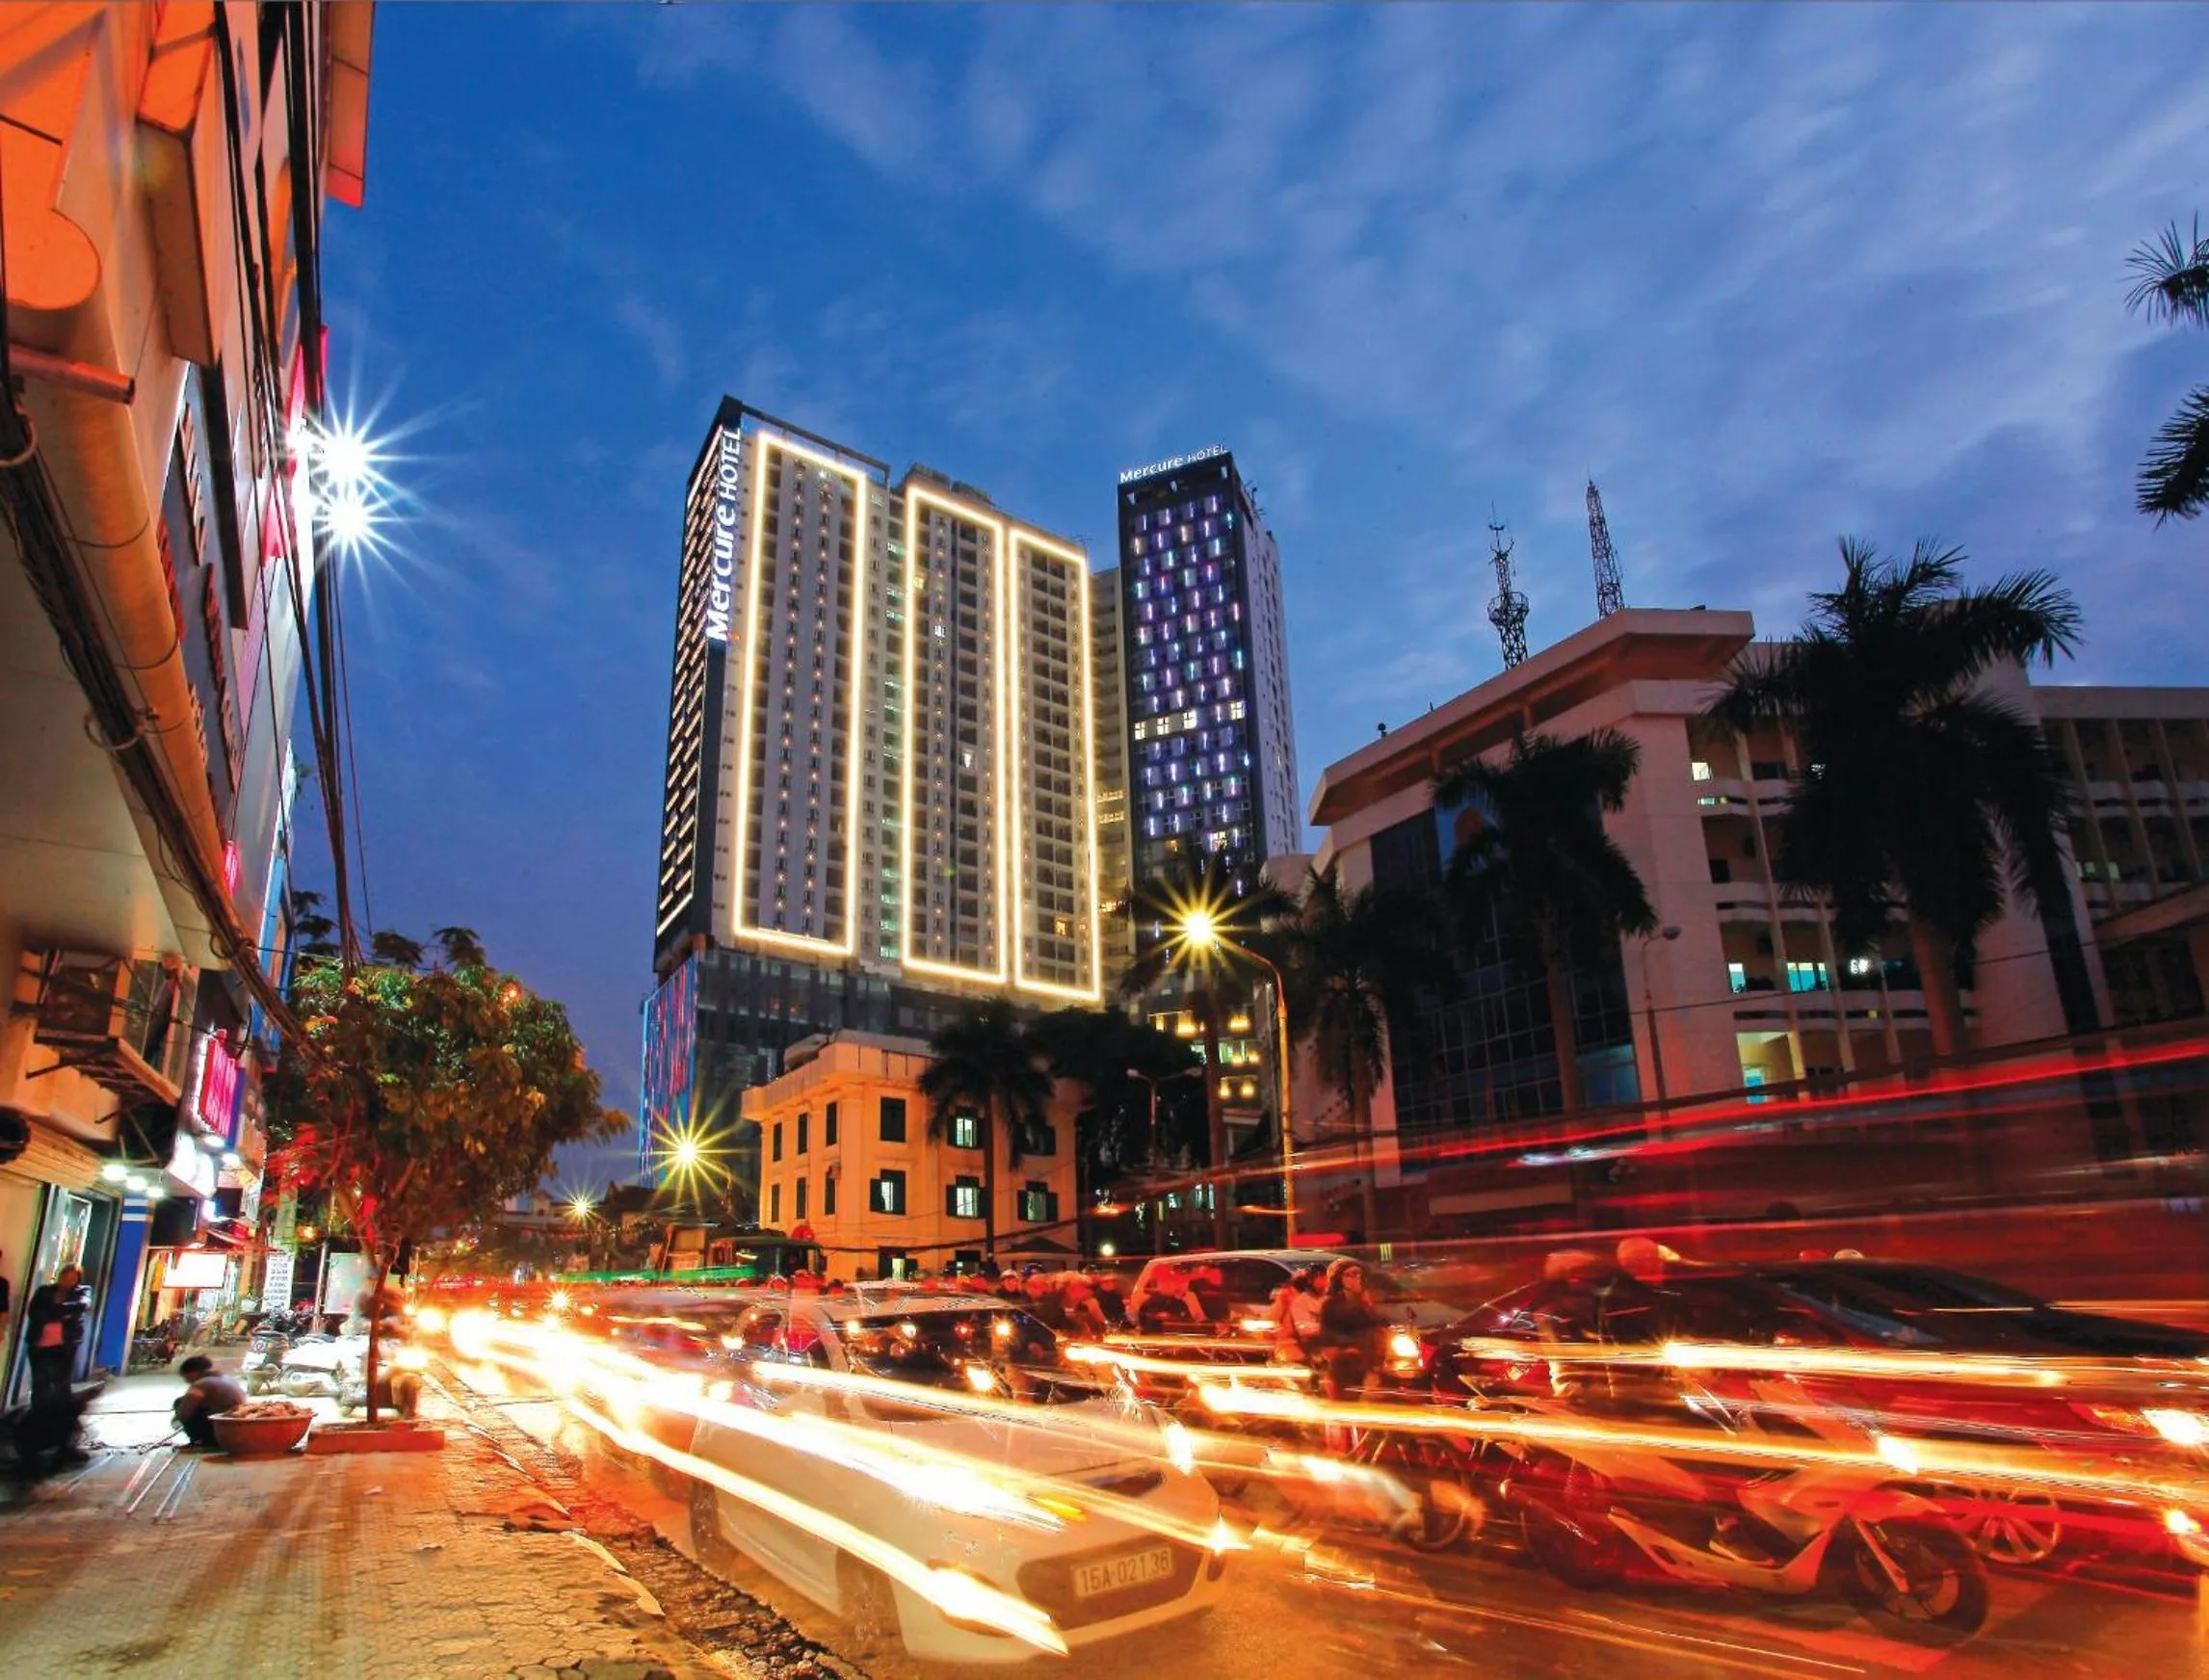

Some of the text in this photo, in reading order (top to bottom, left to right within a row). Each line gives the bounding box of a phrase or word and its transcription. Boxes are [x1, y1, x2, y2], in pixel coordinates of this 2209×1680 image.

[1119, 444, 1228, 484] Mercure HOTEL
[706, 428, 741, 642] Mercure HOTEL
